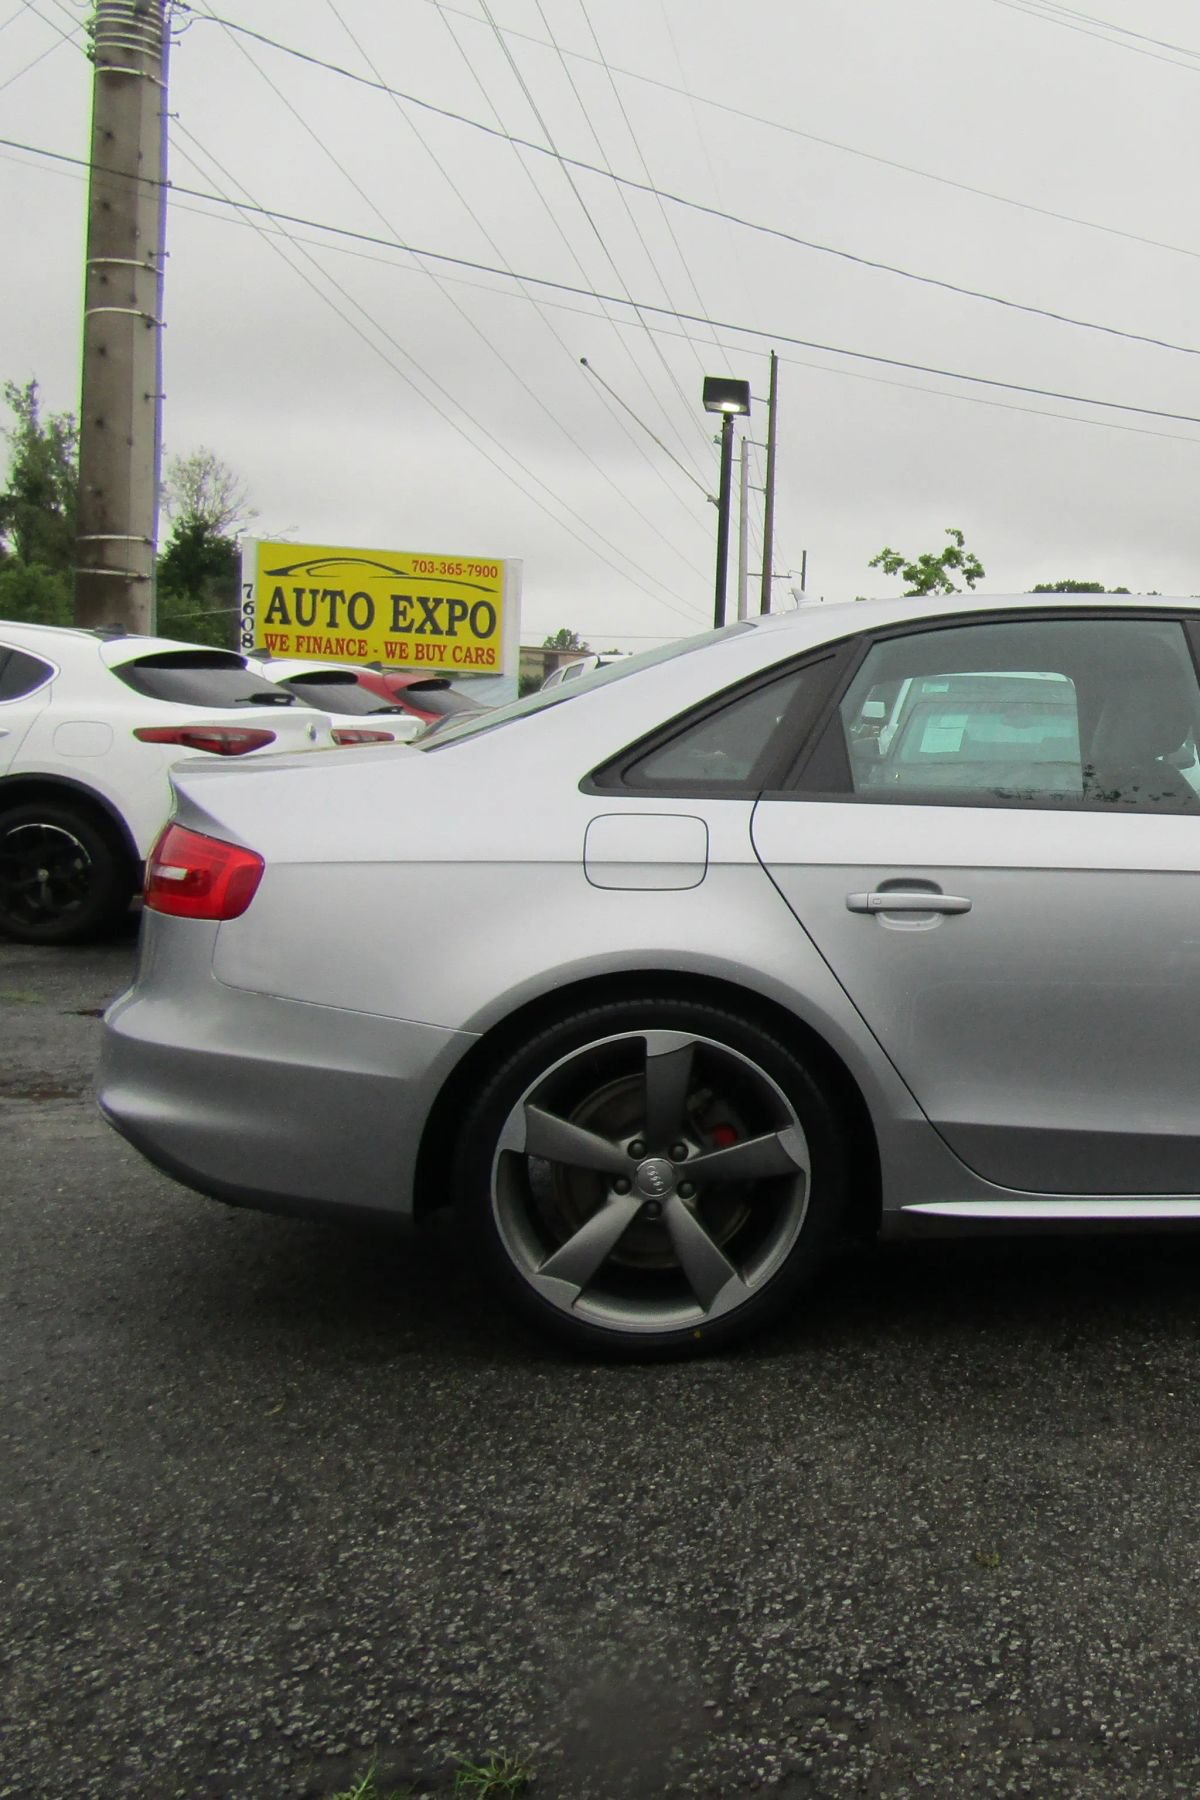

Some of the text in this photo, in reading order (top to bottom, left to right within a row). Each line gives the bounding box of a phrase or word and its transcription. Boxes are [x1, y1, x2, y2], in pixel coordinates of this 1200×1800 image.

[411, 559, 498, 579] 703-365-7900
[241, 583, 255, 649] 7608
[264, 586, 497, 639] AUTO EXPO
[264, 633, 290, 652] WE
[295, 635, 368, 657] FINANCE
[384, 641, 409, 660] WE
[415, 643, 447, 662] BUY
[452, 645, 496, 665] CARS
